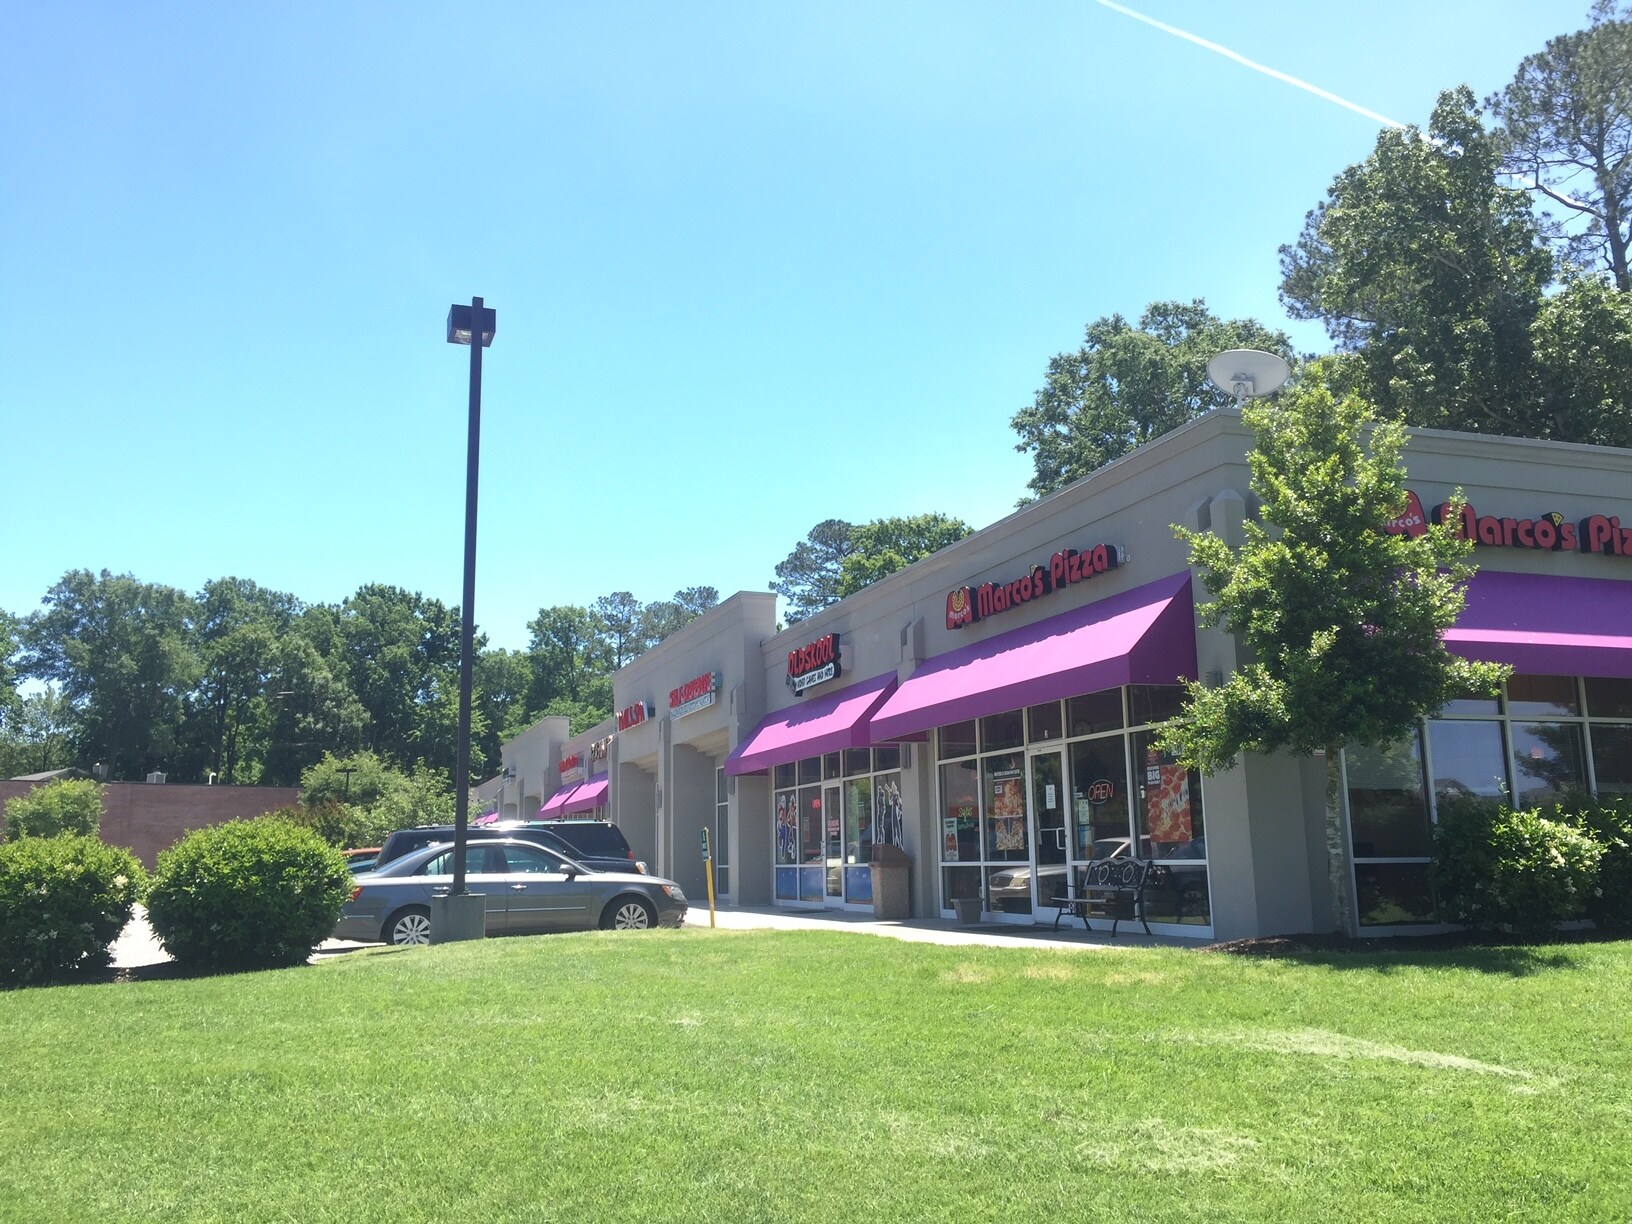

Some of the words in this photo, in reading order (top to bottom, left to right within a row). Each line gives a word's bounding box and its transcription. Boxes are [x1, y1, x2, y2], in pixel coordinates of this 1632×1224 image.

[977, 564, 1043, 618] Marco's
[1050, 543, 1109, 590] Pizza
[1147, 770, 1160, 780] BIG
[1088, 783, 1114, 801] OPEN
